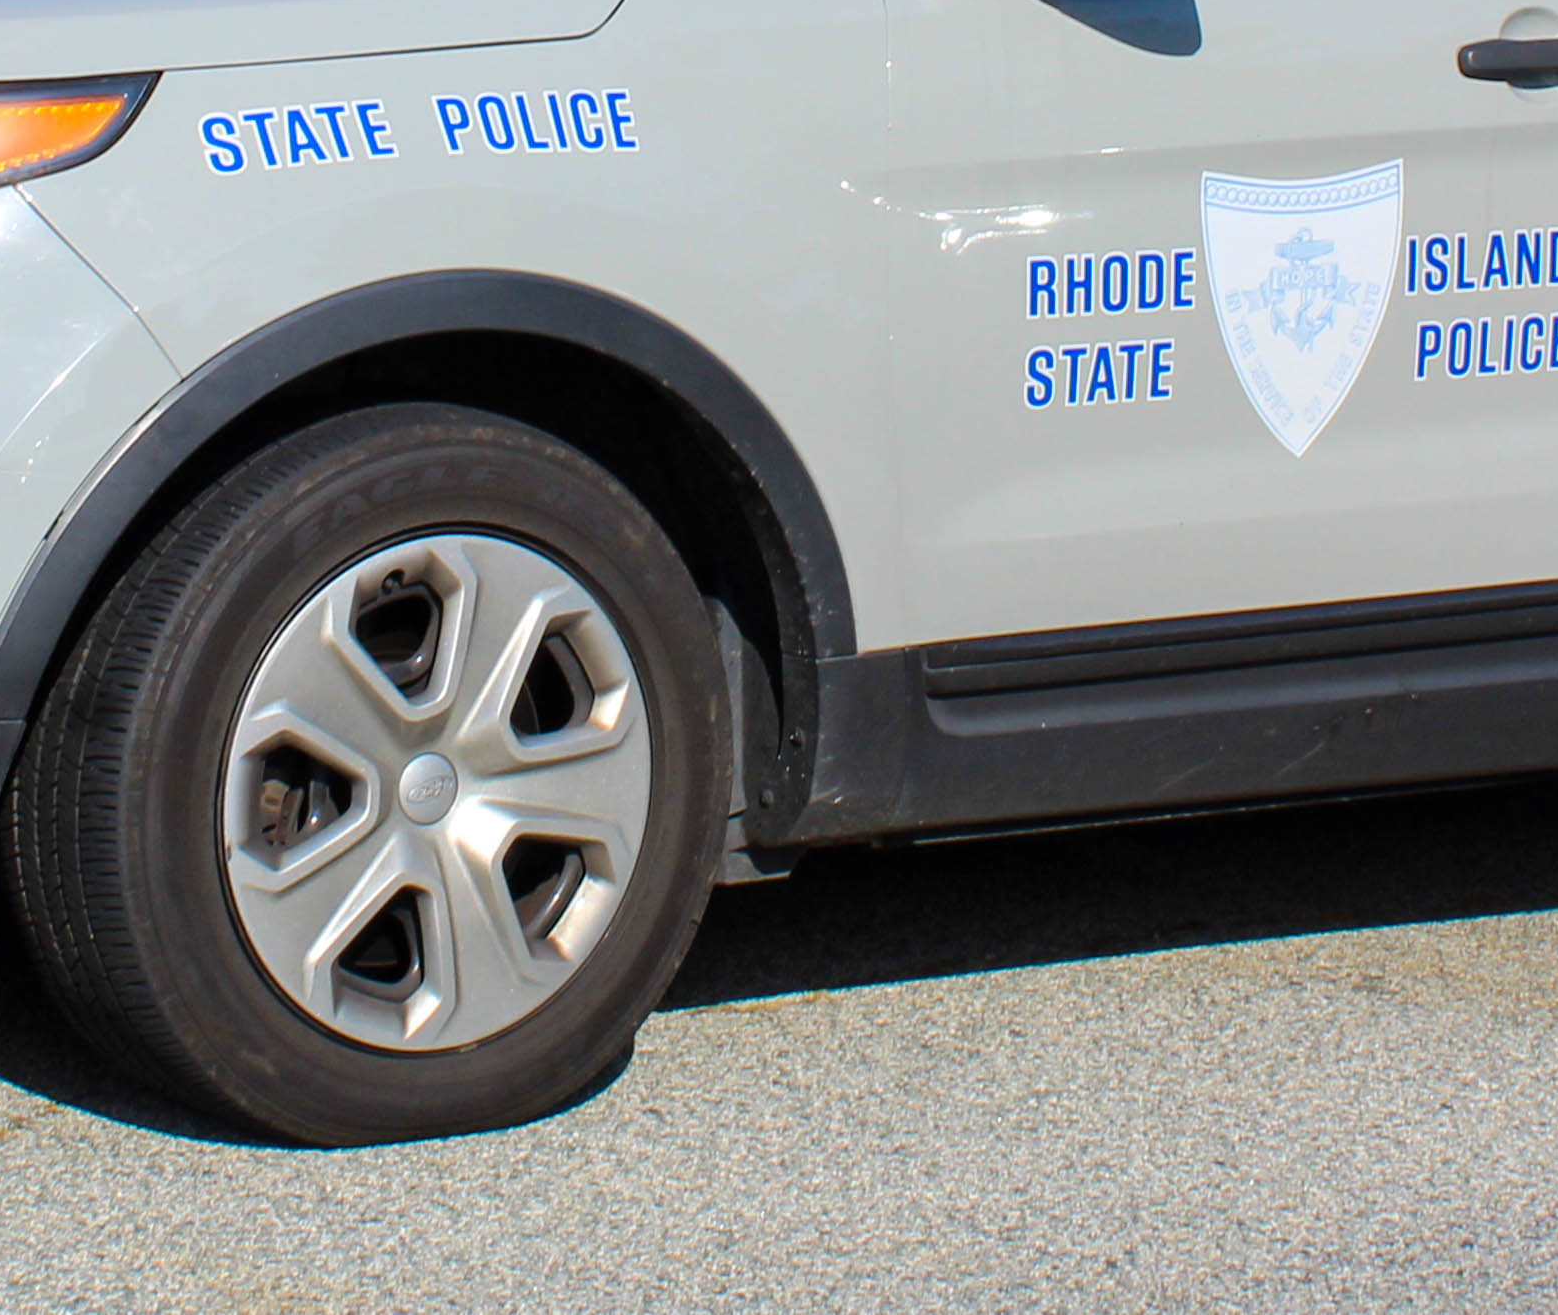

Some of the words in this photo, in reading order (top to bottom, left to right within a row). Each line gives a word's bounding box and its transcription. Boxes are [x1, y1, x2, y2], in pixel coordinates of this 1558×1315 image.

[198, 99, 399, 176] STATE
[431, 88, 639, 156] POLICE
[1026, 247, 1196, 319] RHODE
[1024, 338, 1174, 410] STATE
